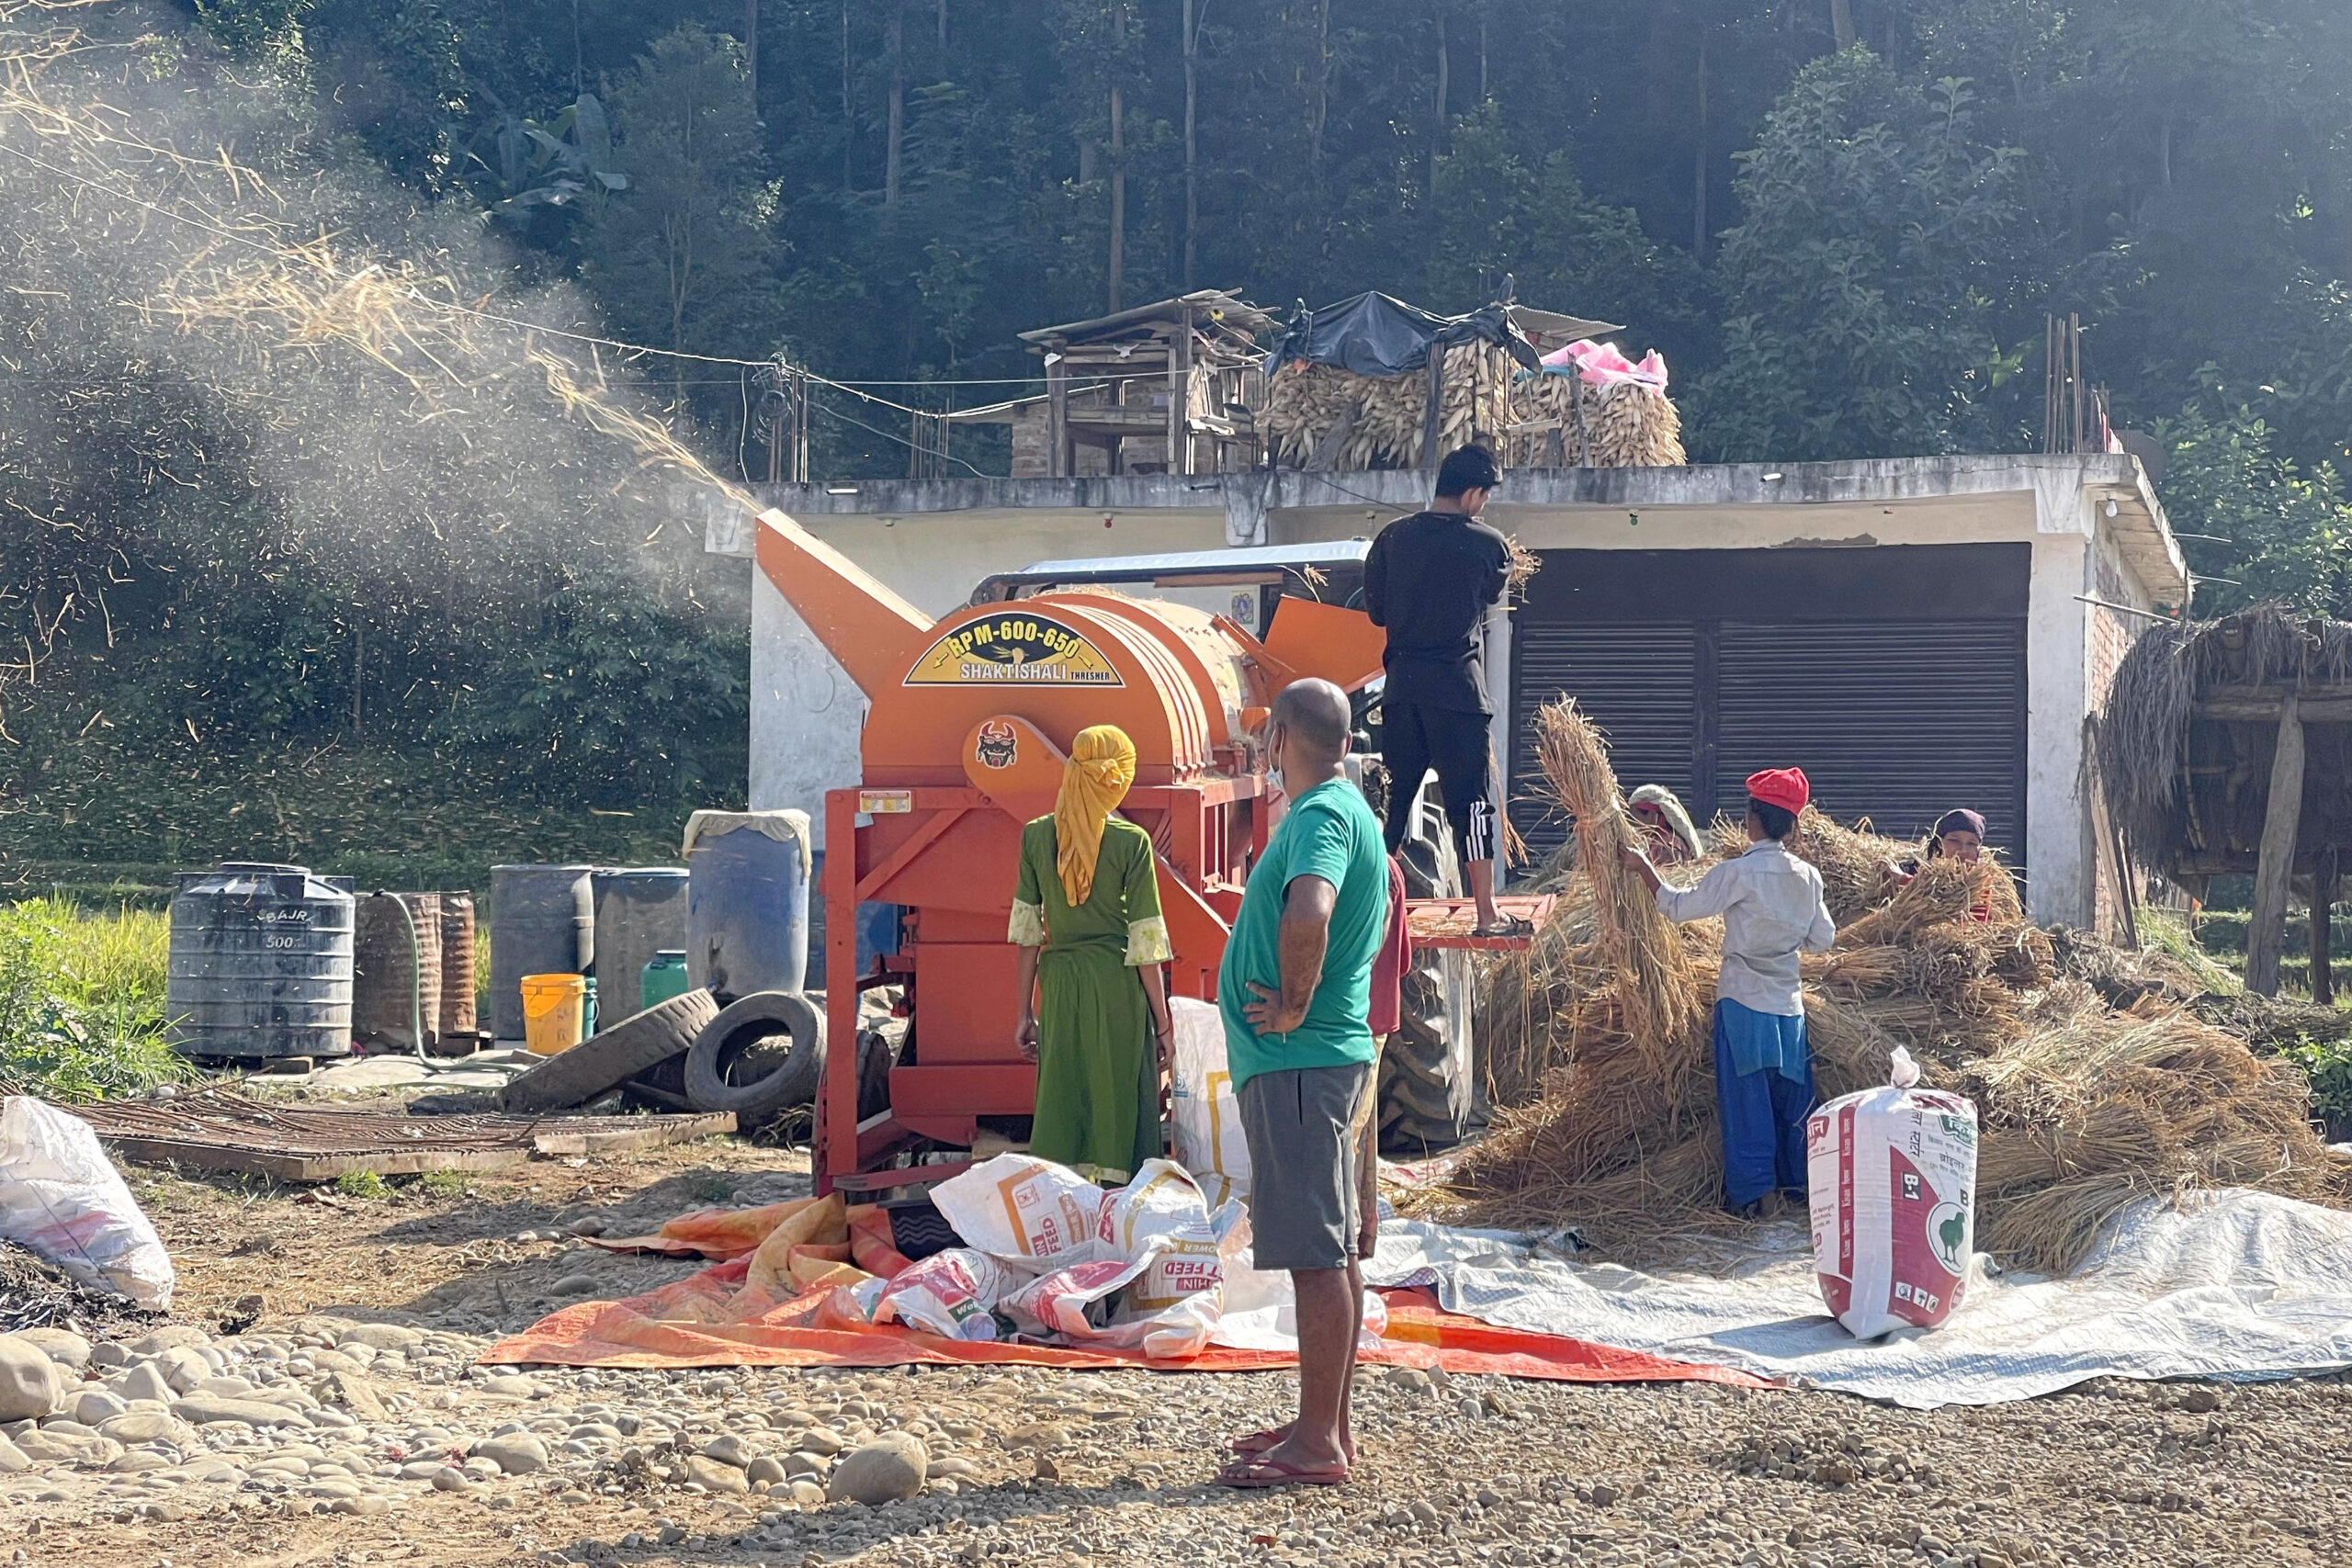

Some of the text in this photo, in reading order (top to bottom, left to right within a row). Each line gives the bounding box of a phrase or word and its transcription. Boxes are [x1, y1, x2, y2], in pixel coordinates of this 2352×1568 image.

[947, 620, 1080, 660] RPM-600-650
[960, 663, 1110, 681] SHAKTISHALI THRESHER
[266, 935, 293, 949] 500
[1904, 1174, 1919, 1201] B-1
[1042, 1217, 1062, 1255] FEED
[1183, 1243, 1216, 1253] OWER
[1164, 1262, 1204, 1275] FEED
[1183, 1279, 1209, 1290] HIN
